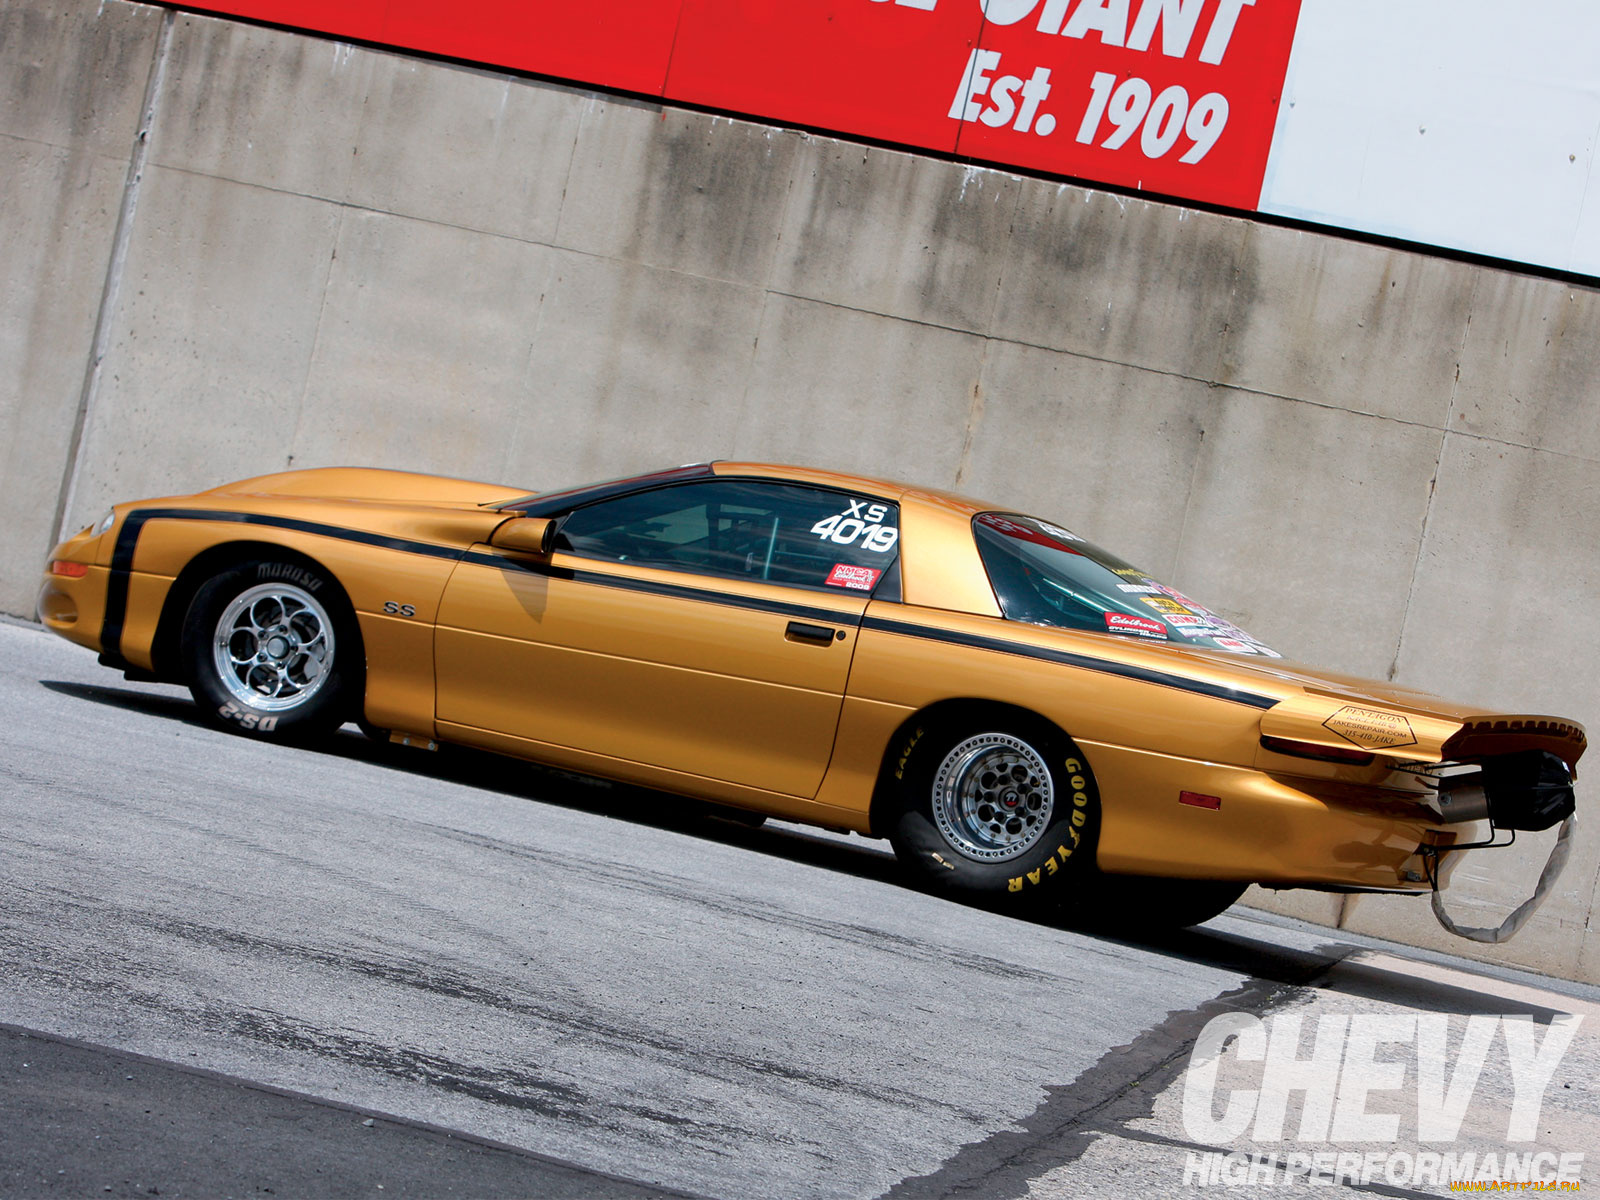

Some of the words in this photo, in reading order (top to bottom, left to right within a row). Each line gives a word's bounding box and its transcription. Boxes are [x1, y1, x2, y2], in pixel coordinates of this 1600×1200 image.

[948, 48, 1057, 137] Est.
[1075, 71, 1230, 165] 1909
[841, 499, 888, 523] XS
[810, 515, 898, 553] 4019
[256, 562, 324, 592] MOROSO
[382, 601, 417, 618] SS
[1110, 615, 1161, 631] Edelbrock
[218, 701, 280, 732] DS-2
[1345, 707, 1405, 723] PENTAGON
[1333, 719, 1407, 738] JAKESREPAIR.COM
[1343, 729, 1397, 745] 315-410-JAKE
[895, 726, 925, 780] EAGLE
